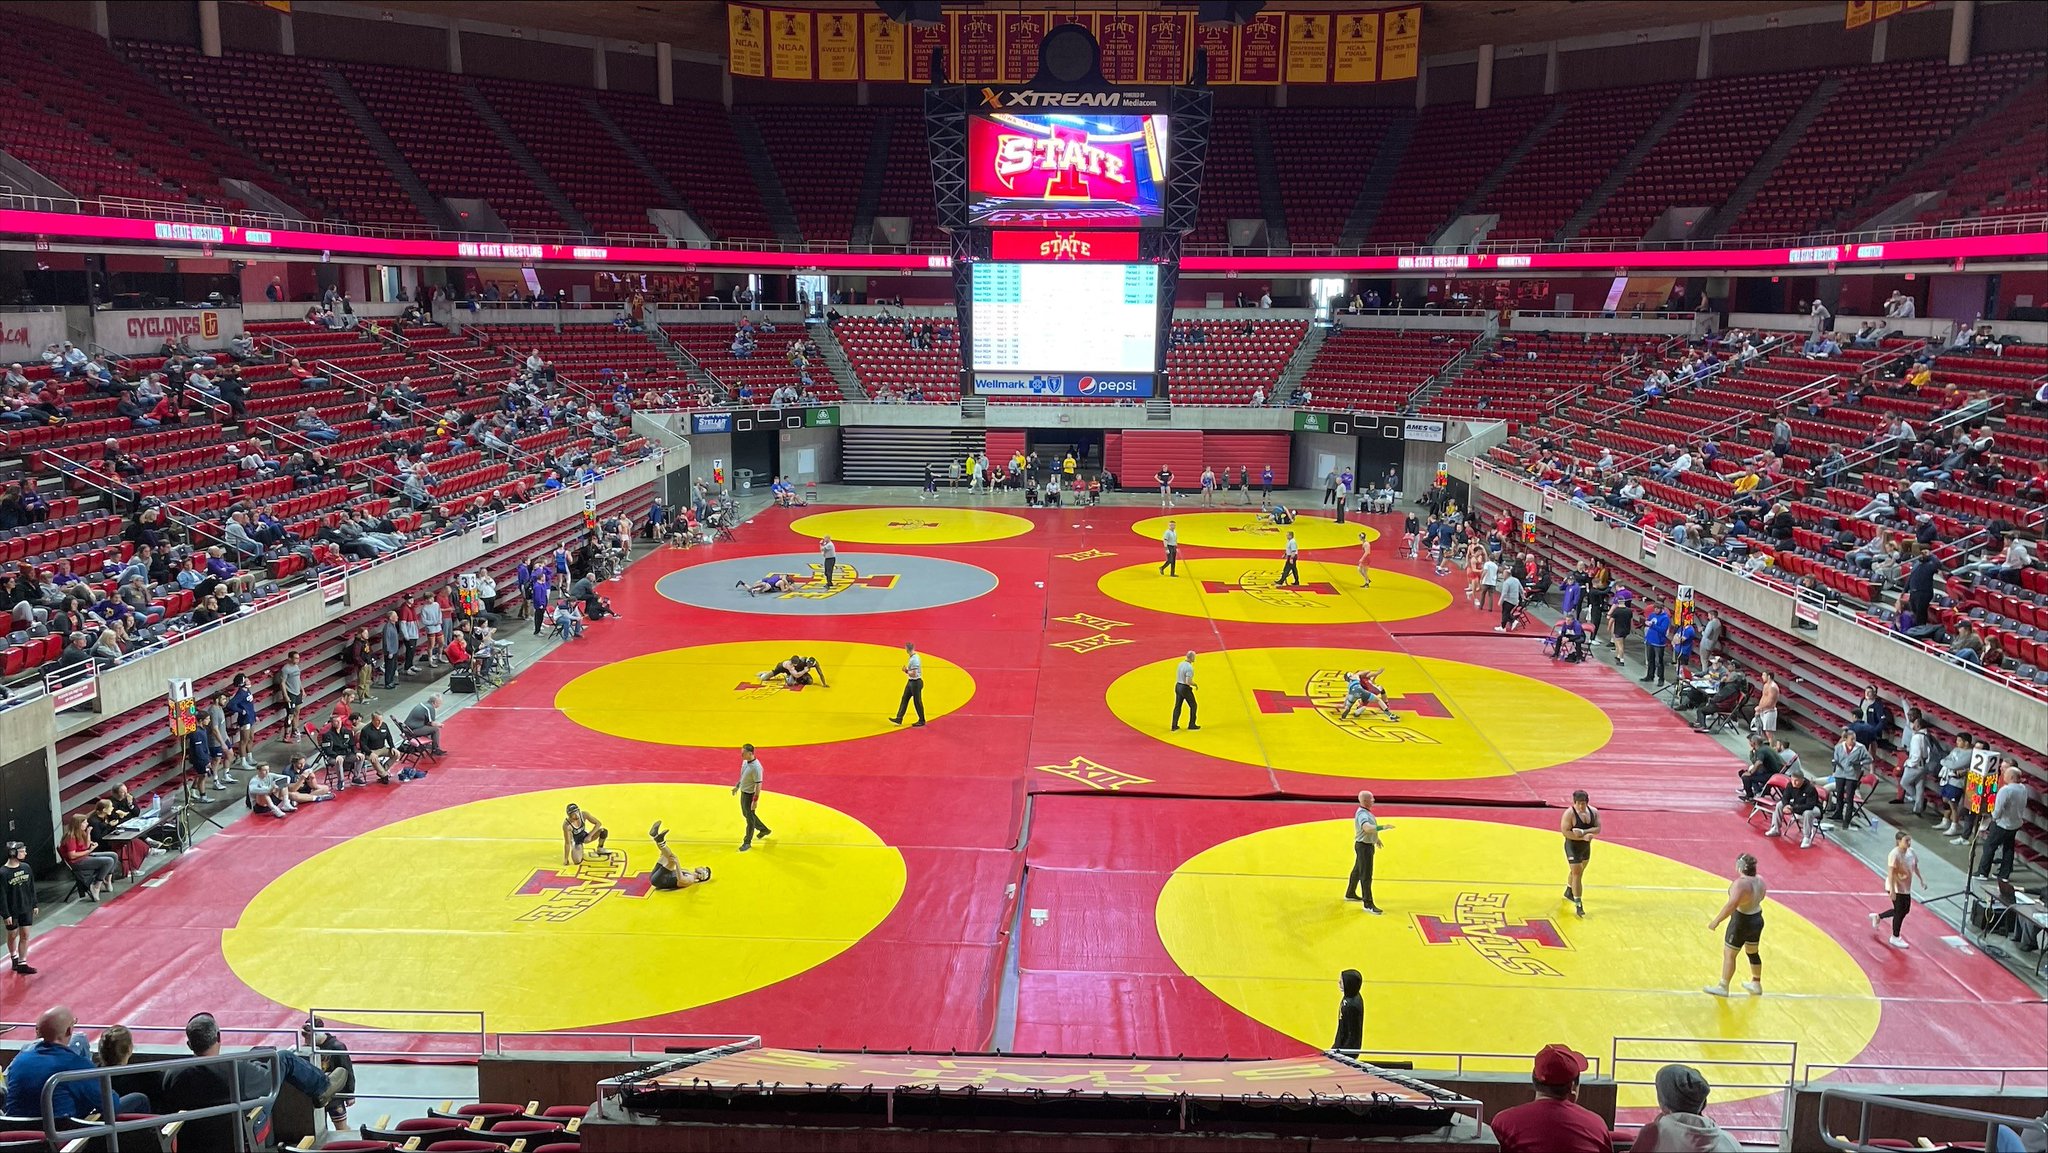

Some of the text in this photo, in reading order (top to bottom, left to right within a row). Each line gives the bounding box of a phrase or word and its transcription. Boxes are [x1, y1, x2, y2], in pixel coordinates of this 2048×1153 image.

[1105, 23, 1134, 33] STATE
[1247, 23, 1276, 33] STATE
[736, 39, 759, 48] NCAA
[1006, 90, 1120, 106] XTREAM
[997, 135, 1127, 185] STATE
[458, 244, 542, 257] IOWA STATE WRESTLING
[1040, 239, 1090, 256] STATE
[928, 256, 945, 267] IOWA
[1415, 256, 1432, 267] STATE
[127, 317, 200, 338] CYCLONES
[976, 380, 1025, 388] Wellmark
[1099, 380, 1137, 392] pepsi
[1529, 514, 1534, 522] 6
[462, 577, 468, 588] 3
[471, 576, 474, 587] 3
[1685, 588, 1691, 599] 4
[180, 682, 187, 697] 1
[1974, 754, 1984, 772] 2
[1988, 756, 1998, 773] 2
[514, 848, 627, 922] STATE
[1455, 892, 1565, 976] STATE
